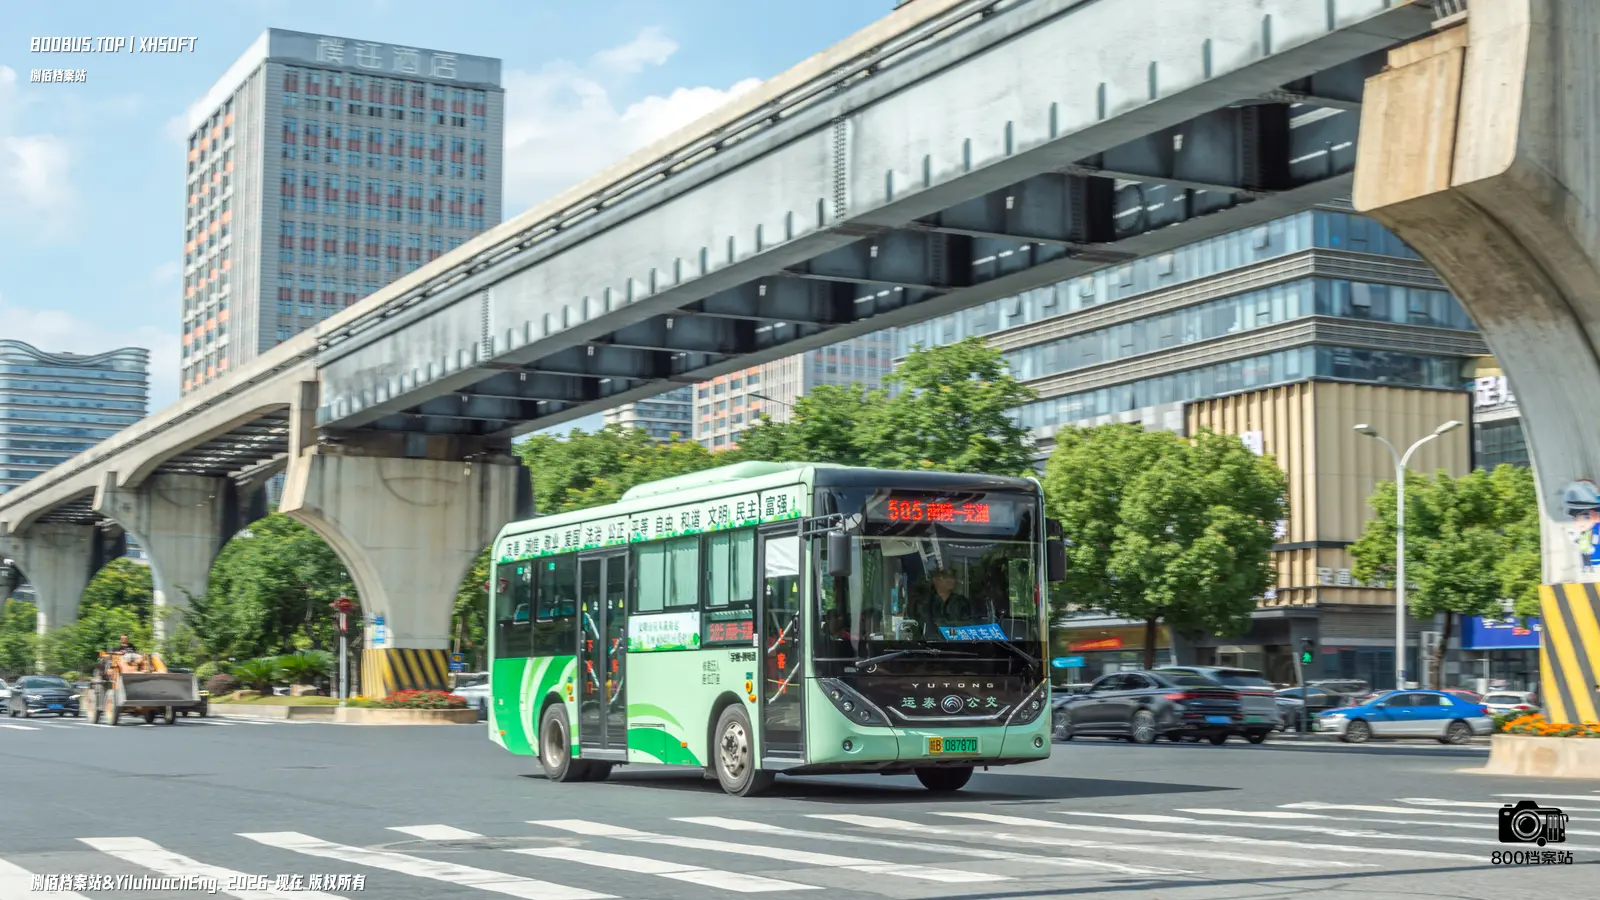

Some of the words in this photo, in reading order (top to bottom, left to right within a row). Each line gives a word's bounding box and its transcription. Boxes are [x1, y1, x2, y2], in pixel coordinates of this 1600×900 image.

[608, 521, 625, 539] 公正
[631, 517, 649, 536] 平等
[655, 514, 674, 533] 自由
[681, 508, 701, 528] 和谐
[707, 504, 728, 526] 文明
[736, 500, 757, 521] 民主
[765, 494, 788, 516] 富强
[887, 499, 923, 521] 505
[901, 696, 937, 710] 运泰
[966, 696, 998, 709] 公交
[945, 739, 977, 752] 08787D
